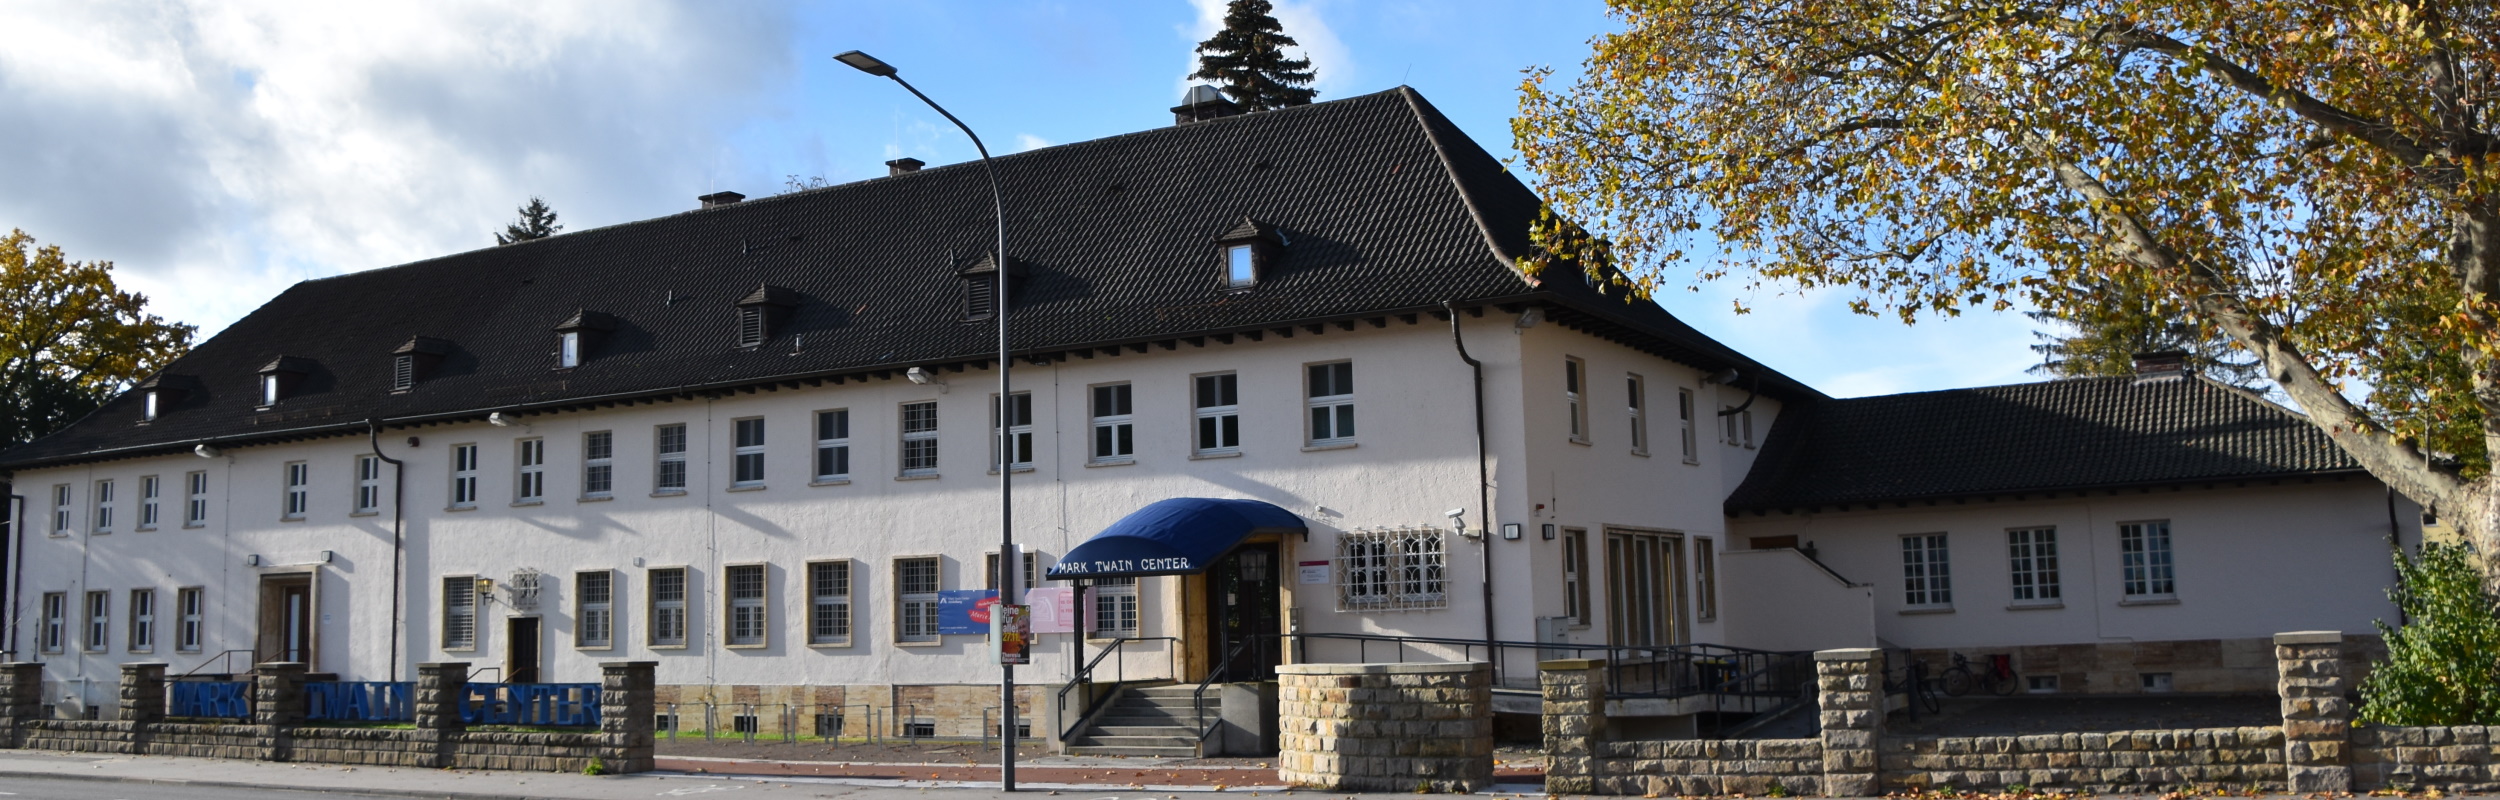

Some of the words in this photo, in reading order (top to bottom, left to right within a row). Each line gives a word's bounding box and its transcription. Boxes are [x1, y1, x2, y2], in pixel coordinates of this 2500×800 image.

[1059, 562, 1088, 573] MARK
[1095, 559, 1132, 572] TWAIN
[1141, 557, 1188, 570] CENTER
[173, 682, 249, 718] MARK
[304, 683, 414, 720] TWAIN
[458, 684, 601, 725] CENTER
